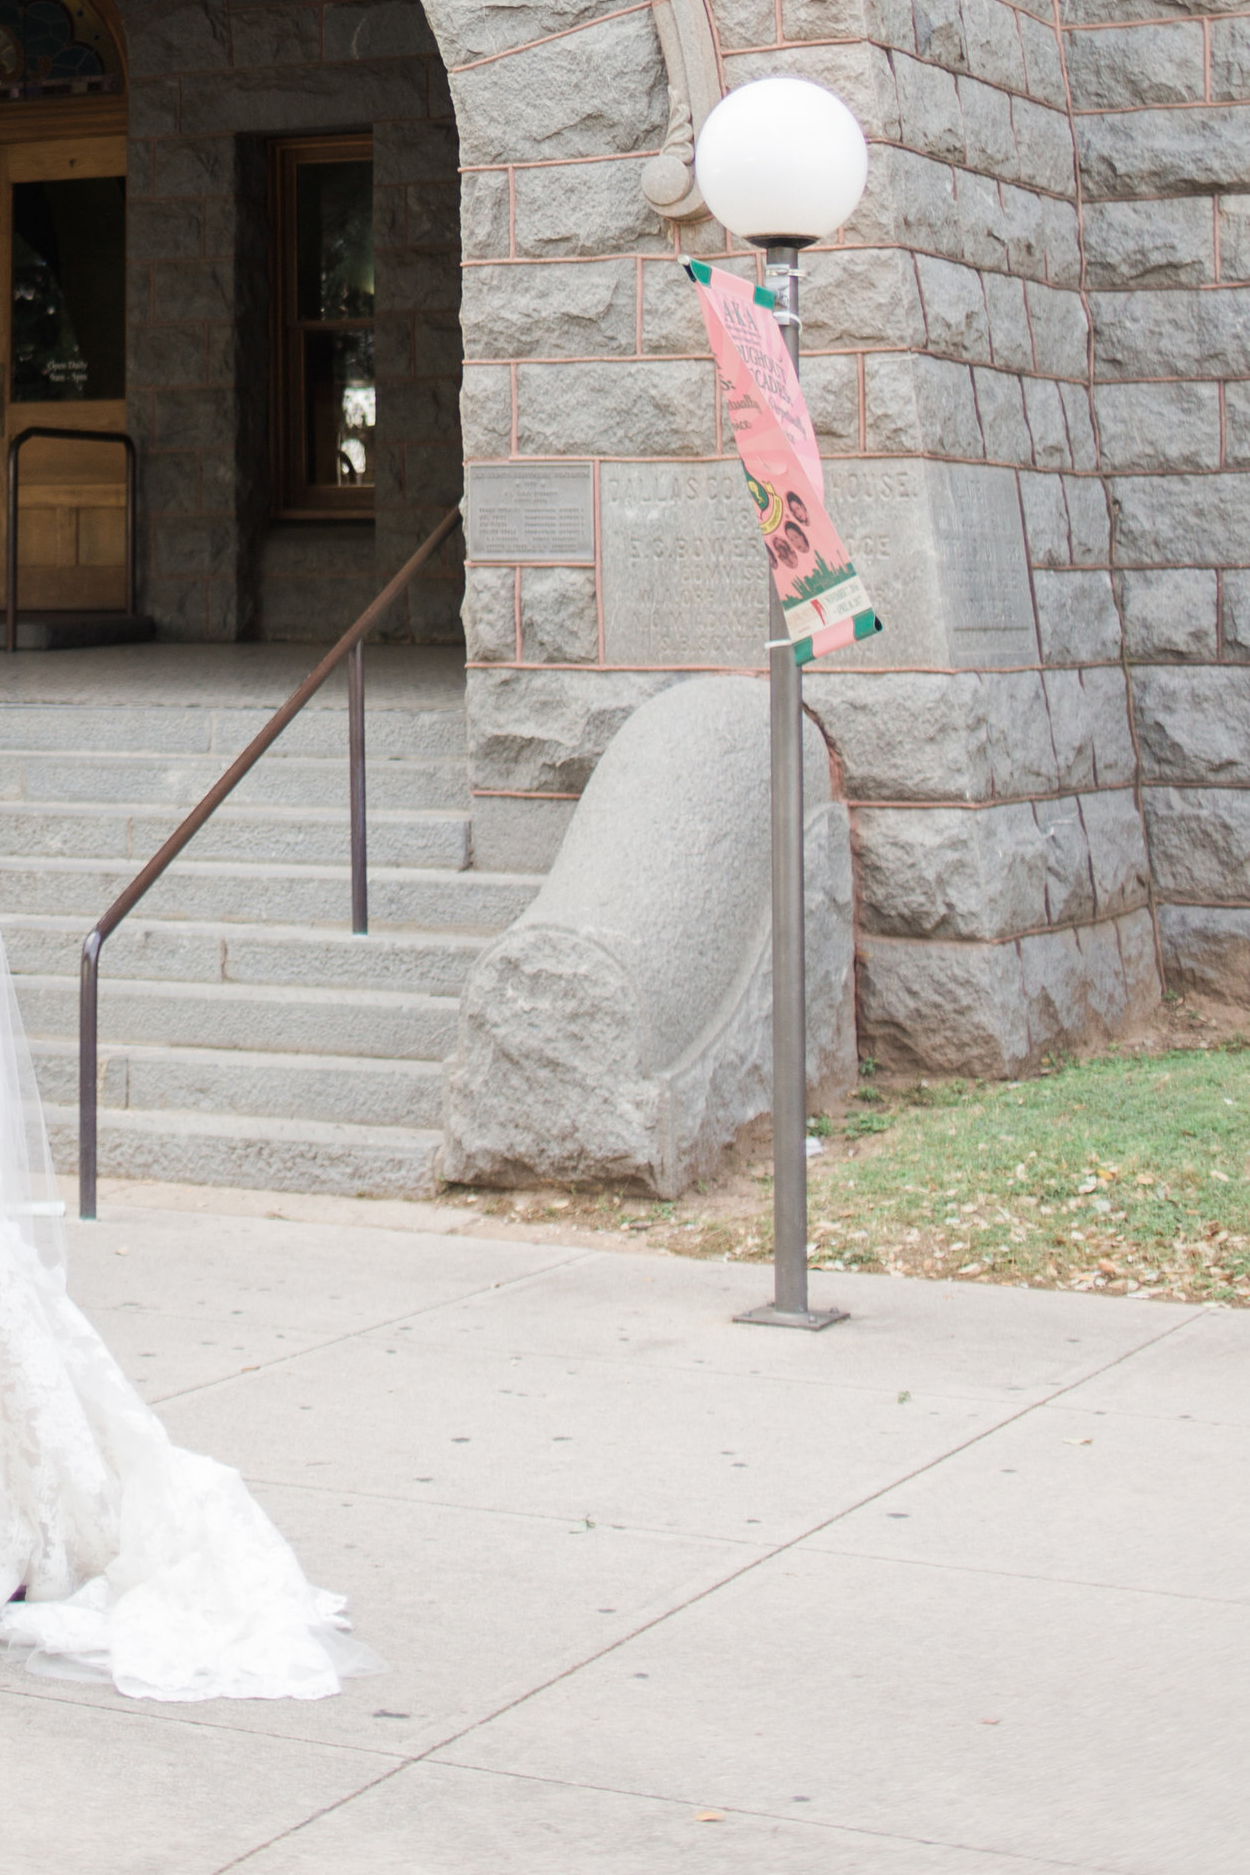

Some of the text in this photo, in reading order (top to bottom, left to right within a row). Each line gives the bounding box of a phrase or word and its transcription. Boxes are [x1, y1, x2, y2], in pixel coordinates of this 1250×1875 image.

[47, 360, 88, 372] Open Daily
[608, 476, 699, 502] DALLAS
